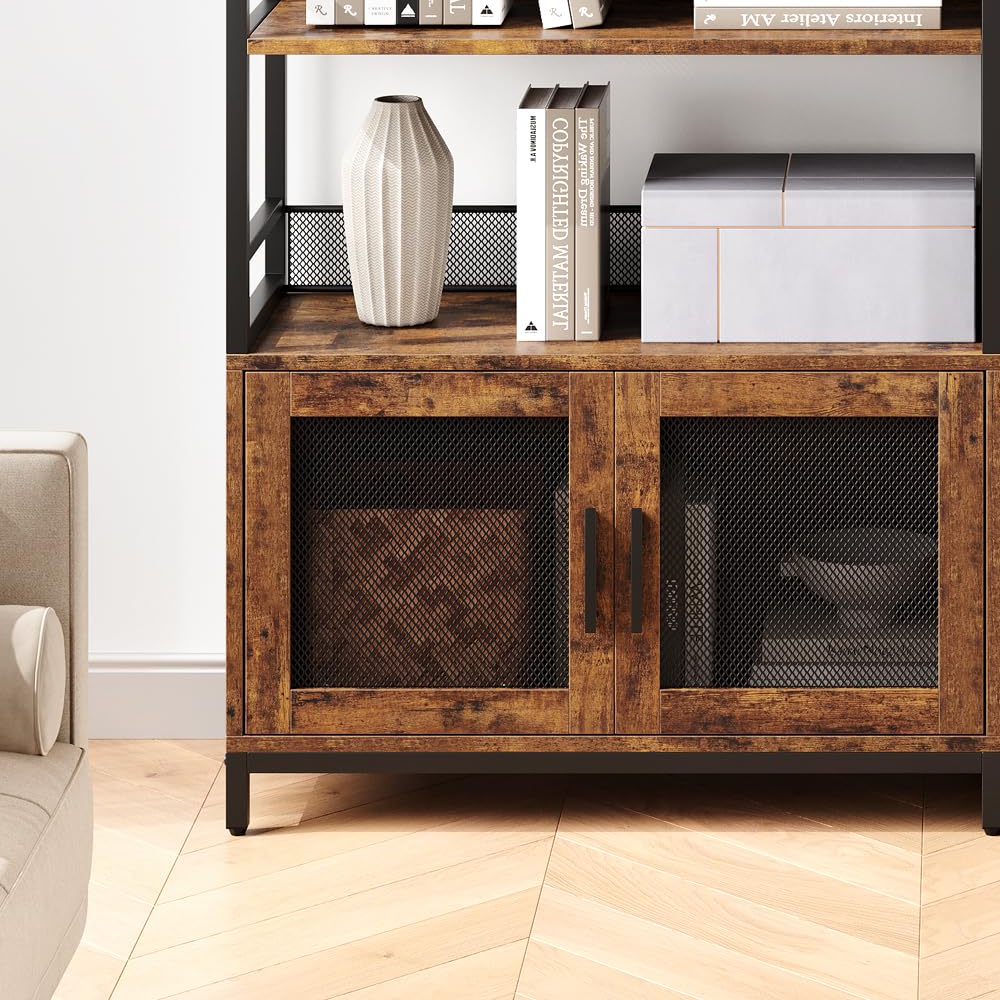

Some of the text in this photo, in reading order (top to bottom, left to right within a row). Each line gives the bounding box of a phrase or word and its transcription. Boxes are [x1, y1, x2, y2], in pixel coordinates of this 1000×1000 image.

[741, 12, 922, 28] Interiors Atelier AM
